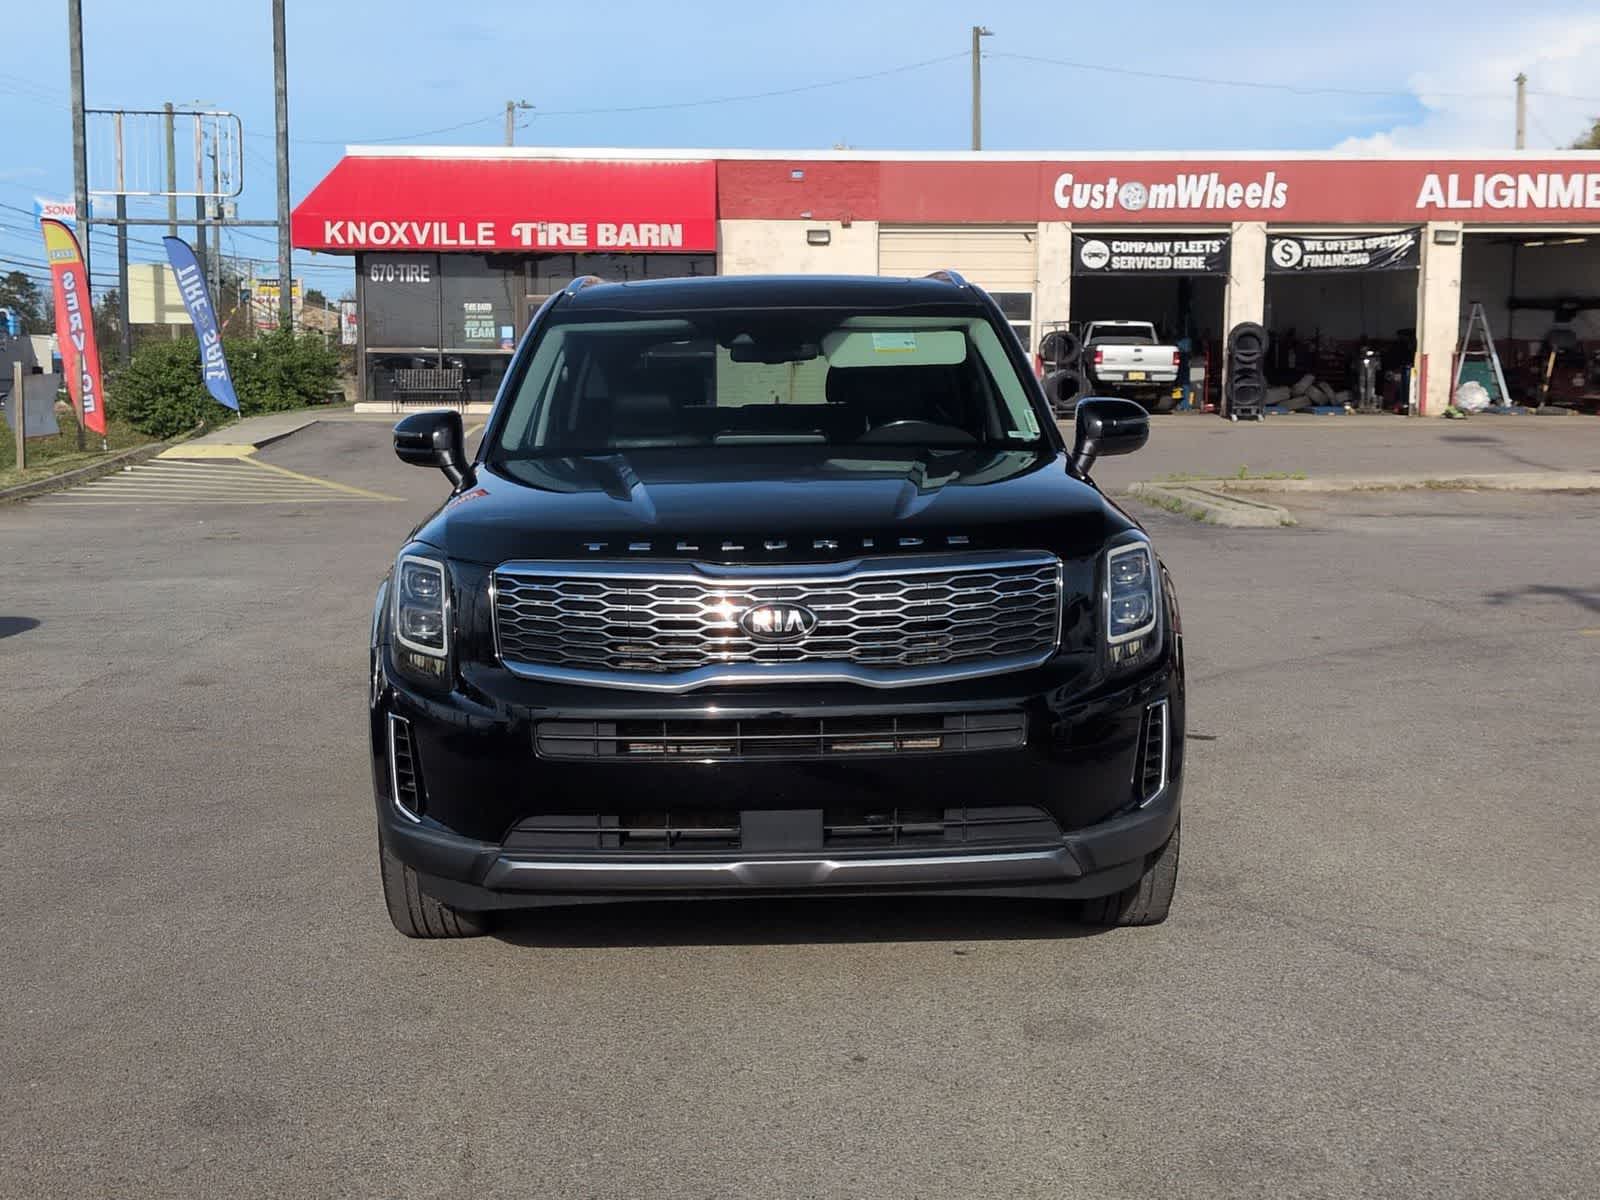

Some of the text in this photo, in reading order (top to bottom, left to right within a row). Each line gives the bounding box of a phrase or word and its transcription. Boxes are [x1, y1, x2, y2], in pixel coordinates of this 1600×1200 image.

[1416, 174, 1600, 208] ALIGNME
[45, 205, 77, 216] SONI
[324, 221, 496, 246] KNOXVILLE
[597, 223, 683, 247] BARN
[1112, 239, 1221, 253] COMPANY FLEETS
[1303, 240, 1325, 252] WE
[1325, 239, 1364, 251] OFFER
[1111, 256, 1206, 270] SERVICED HERE
[1303, 252, 1371, 268] FINANCING
[370, 264, 431, 283] 670-TIRE
[464, 327, 496, 338] TEAM
[583, 535, 970, 552] TELLURIDE
[751, 609, 807, 633] KIA
